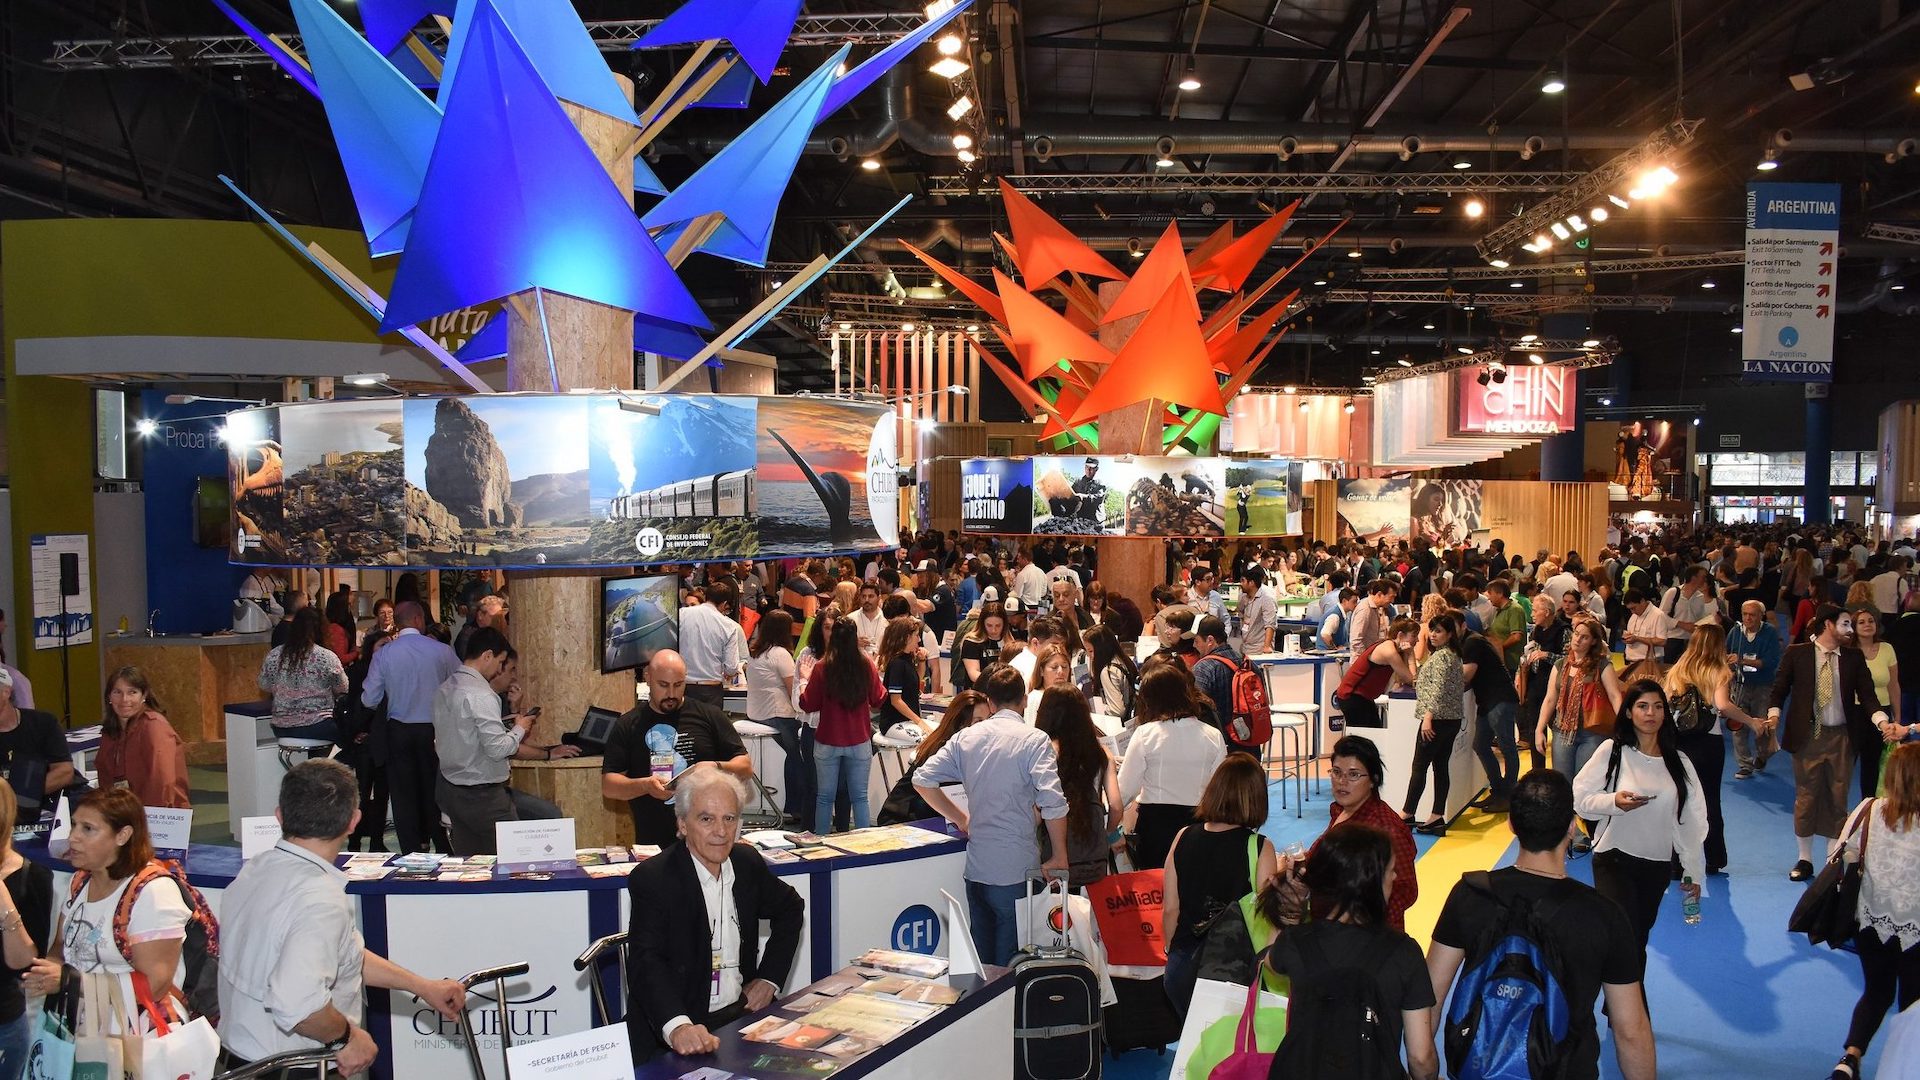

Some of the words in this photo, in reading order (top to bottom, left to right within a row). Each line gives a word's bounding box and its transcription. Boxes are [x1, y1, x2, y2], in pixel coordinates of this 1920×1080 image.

[1746, 190, 1757, 229] AVENIDA
[1767, 200, 1836, 214] ARGENTINA
[1772, 240, 1784, 248] por
[1784, 281, 1815, 290] Negocios
[1770, 310, 1792, 318] Parking
[1769, 350, 1807, 359] Argentina
[1743, 361, 1764, 372] LA
[1769, 362, 1832, 374] NACION
[1483, 389, 1564, 416] CHIN
[1484, 420, 1560, 433] MENDOZA
[165, 426, 205, 449] Proba
[639, 534, 659, 548] CFI
[896, 918, 933, 952] CFI
[484, 1040, 499, 1050] DE
[580, 1047, 591, 1056] DE
[545, 1062, 574, 1073] Gobierno
[586, 1054, 608, 1064] Chubut
